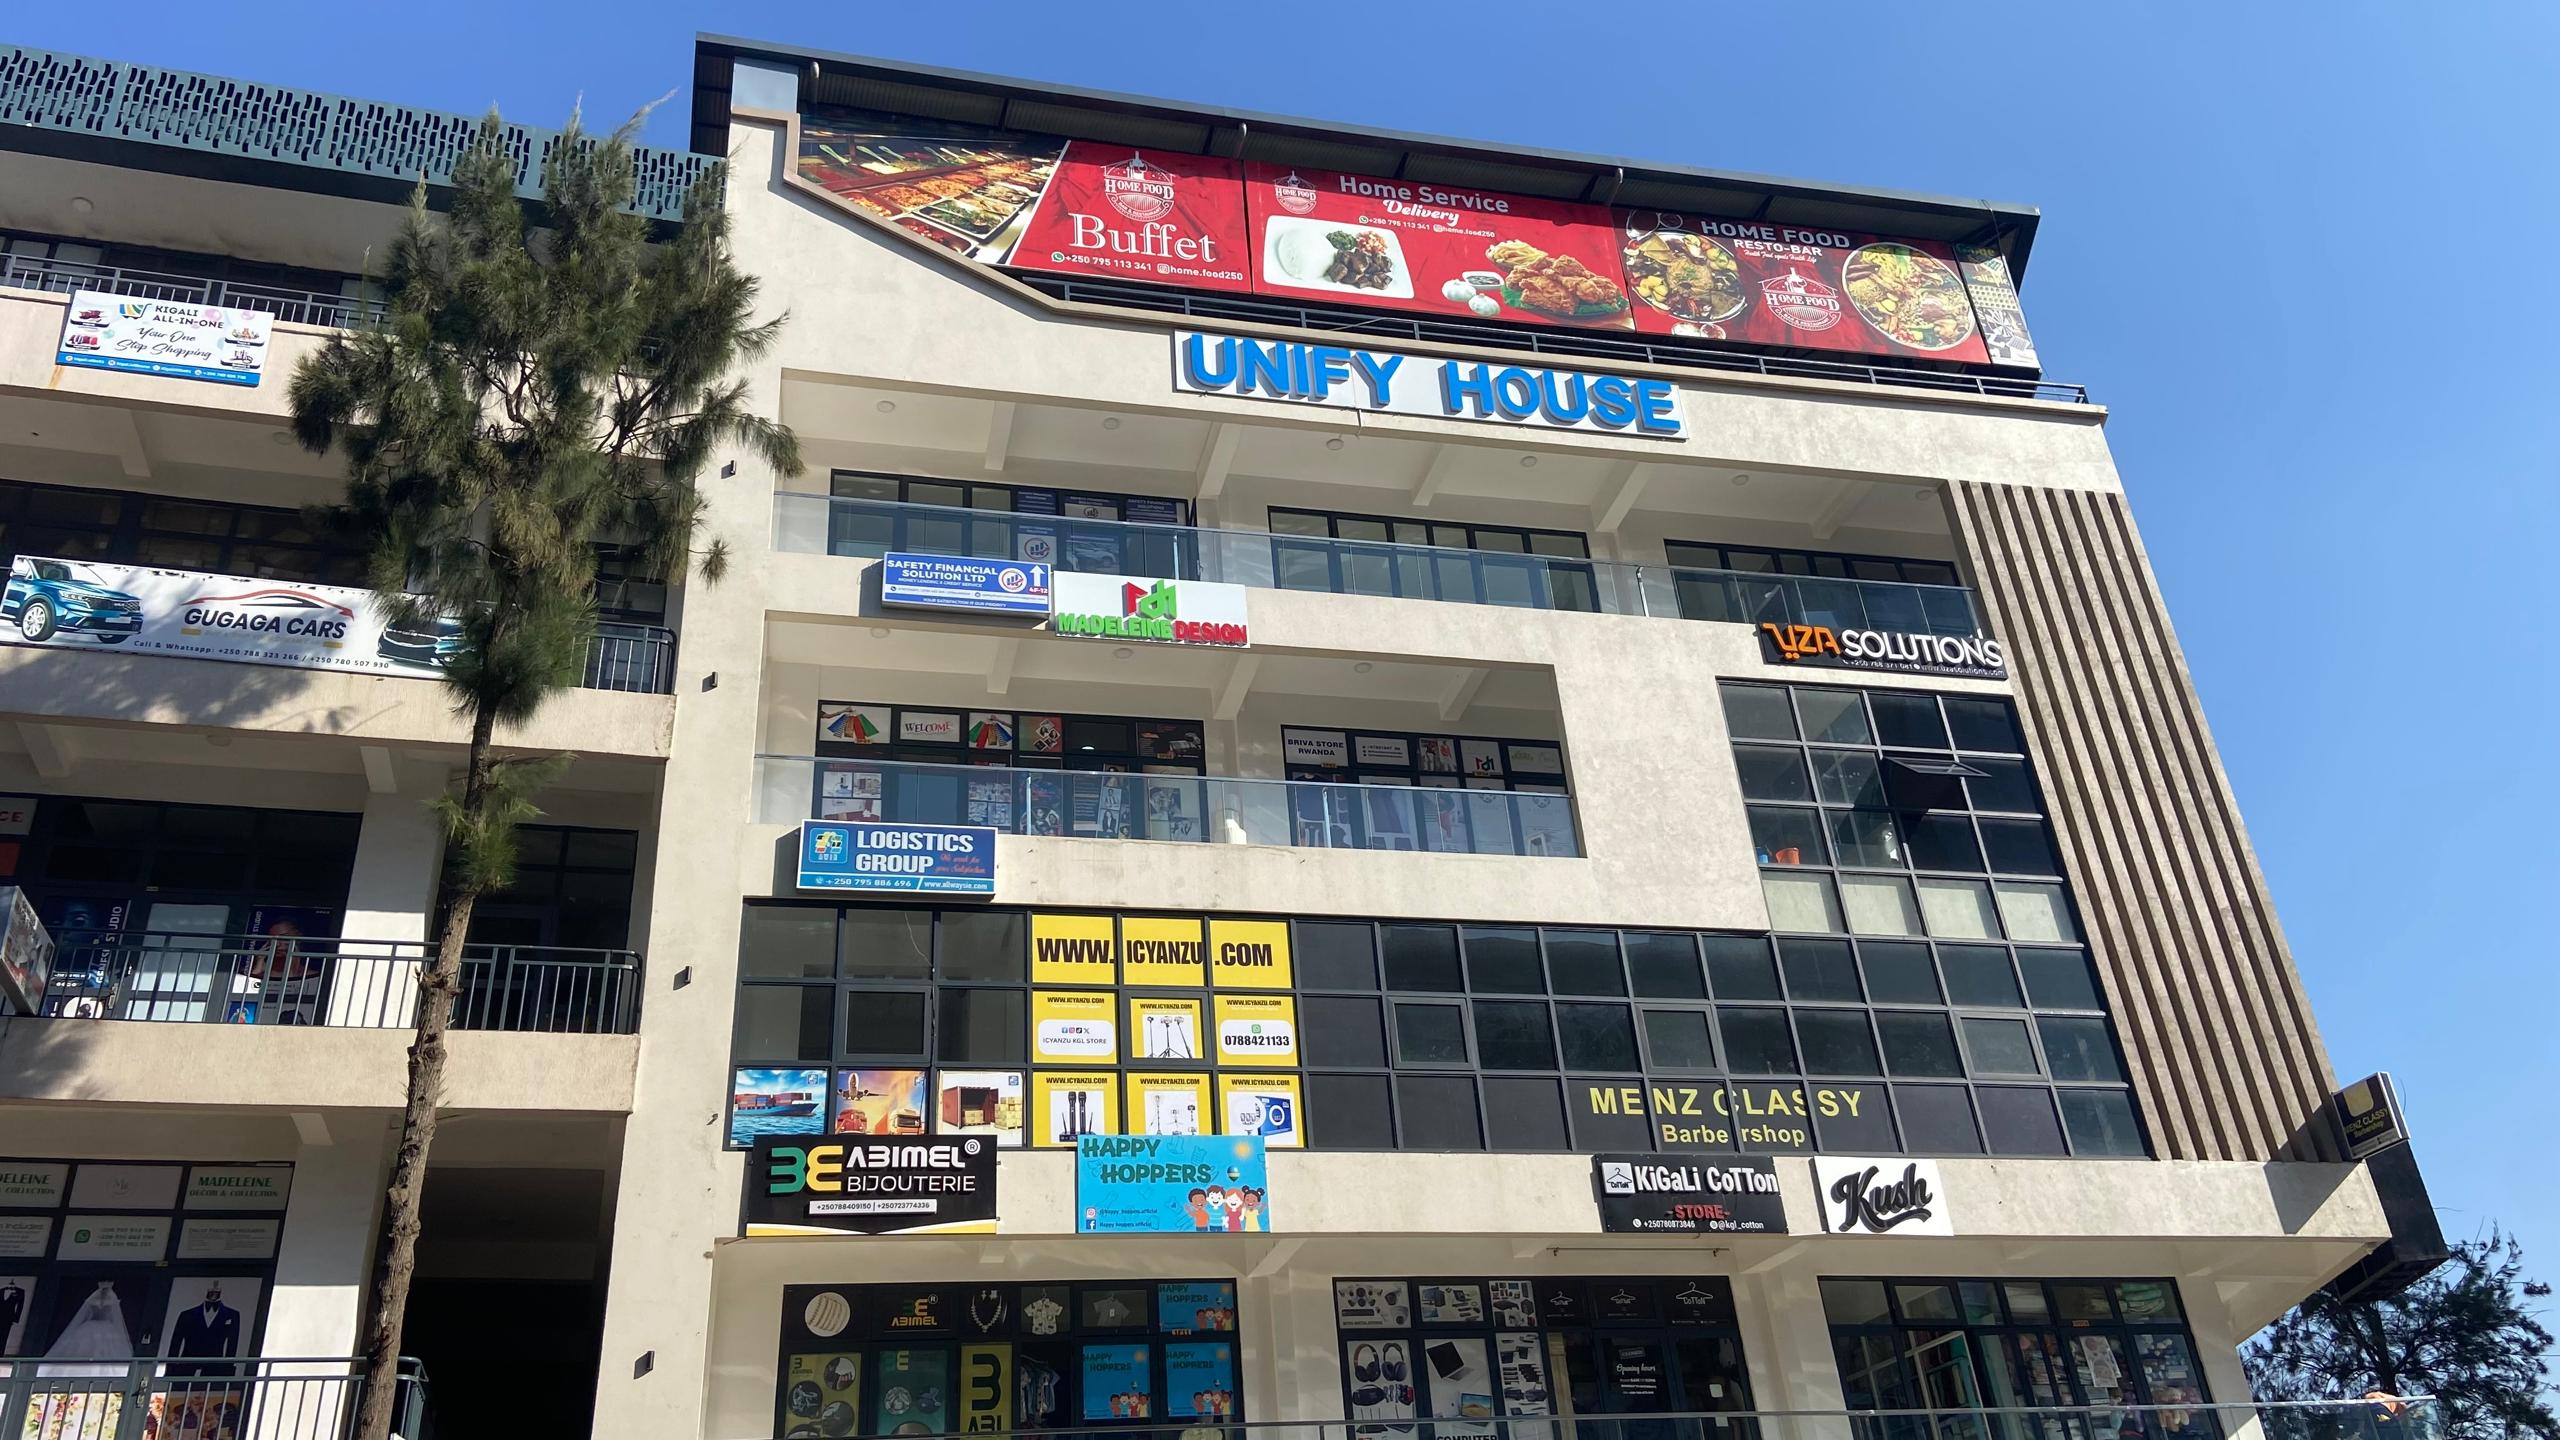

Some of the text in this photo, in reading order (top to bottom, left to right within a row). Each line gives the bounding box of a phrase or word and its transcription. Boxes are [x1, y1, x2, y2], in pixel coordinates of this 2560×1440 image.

[1104, 178, 1175, 200] HOME FOOD
[1340, 175, 1510, 213] Home Service
[1383, 199, 1460, 228] Delivery
[1068, 212, 1217, 263] Buffet
[1701, 221, 1850, 249] HOME FOOD
[1733, 238, 1824, 257] RESTO-BAR
[1065, 254, 1152, 271] +250 795 113 341
[1170, 264, 1243, 281] home.food250
[155, 305, 198, 317] KIGALI
[1765, 292, 1840, 311] HOME FOOD
[152, 315, 225, 329] ALL-IN-ONE
[137, 326, 196, 343] Your One
[149, 342, 212, 361] Shopping
[1187, 333, 1682, 434] UNIFY HOUSE
[887, 559, 999, 576] SAFETY FINANCIAL
[902, 568, 986, 583] SOLUTION LTD
[184, 607, 282, 634] GUGAGA
[286, 617, 347, 639] CARS
[1057, 613, 1248, 645] MADELEINE DESIGN
[134, 640, 152, 648] Call
[1762, 623, 2004, 667] UZA SOLUTIONS
[1288, 738, 1344, 749] BRIVA STORE
[1298, 747, 1336, 757] RWANDA
[856, 830, 973, 853] LOGISTICS
[856, 852, 934, 874] GROUP
[1037, 938, 1273, 967] WWW. ICYANZU .COM
[1225, 1035, 1290, 1047] 0788421133
[1589, 1087, 1862, 1117] MENZ CLASSY
[1662, 1124, 1806, 1147] Barbershop
[846, 1145, 966, 1169] ABIMEL
[1082, 1137, 1161, 1158] HAPPY
[199, 1176, 273, 1187] MADELEINE
[1101, 1163, 1212, 1184] HOPPERS
[847, 1175, 976, 1192] BIJOUTERIE
[1830, 1163, 1933, 1233] Kush
[1159, 1285, 1188, 1293] HAPPY
[1166, 1294, 1208, 1304] HOPPERS
[1083, 1353, 1113, 1361] HAPPY
[1173, 1361, 1214, 1370] HOPPERS
[1090, 1363, 1132, 1372] HOPPERS
